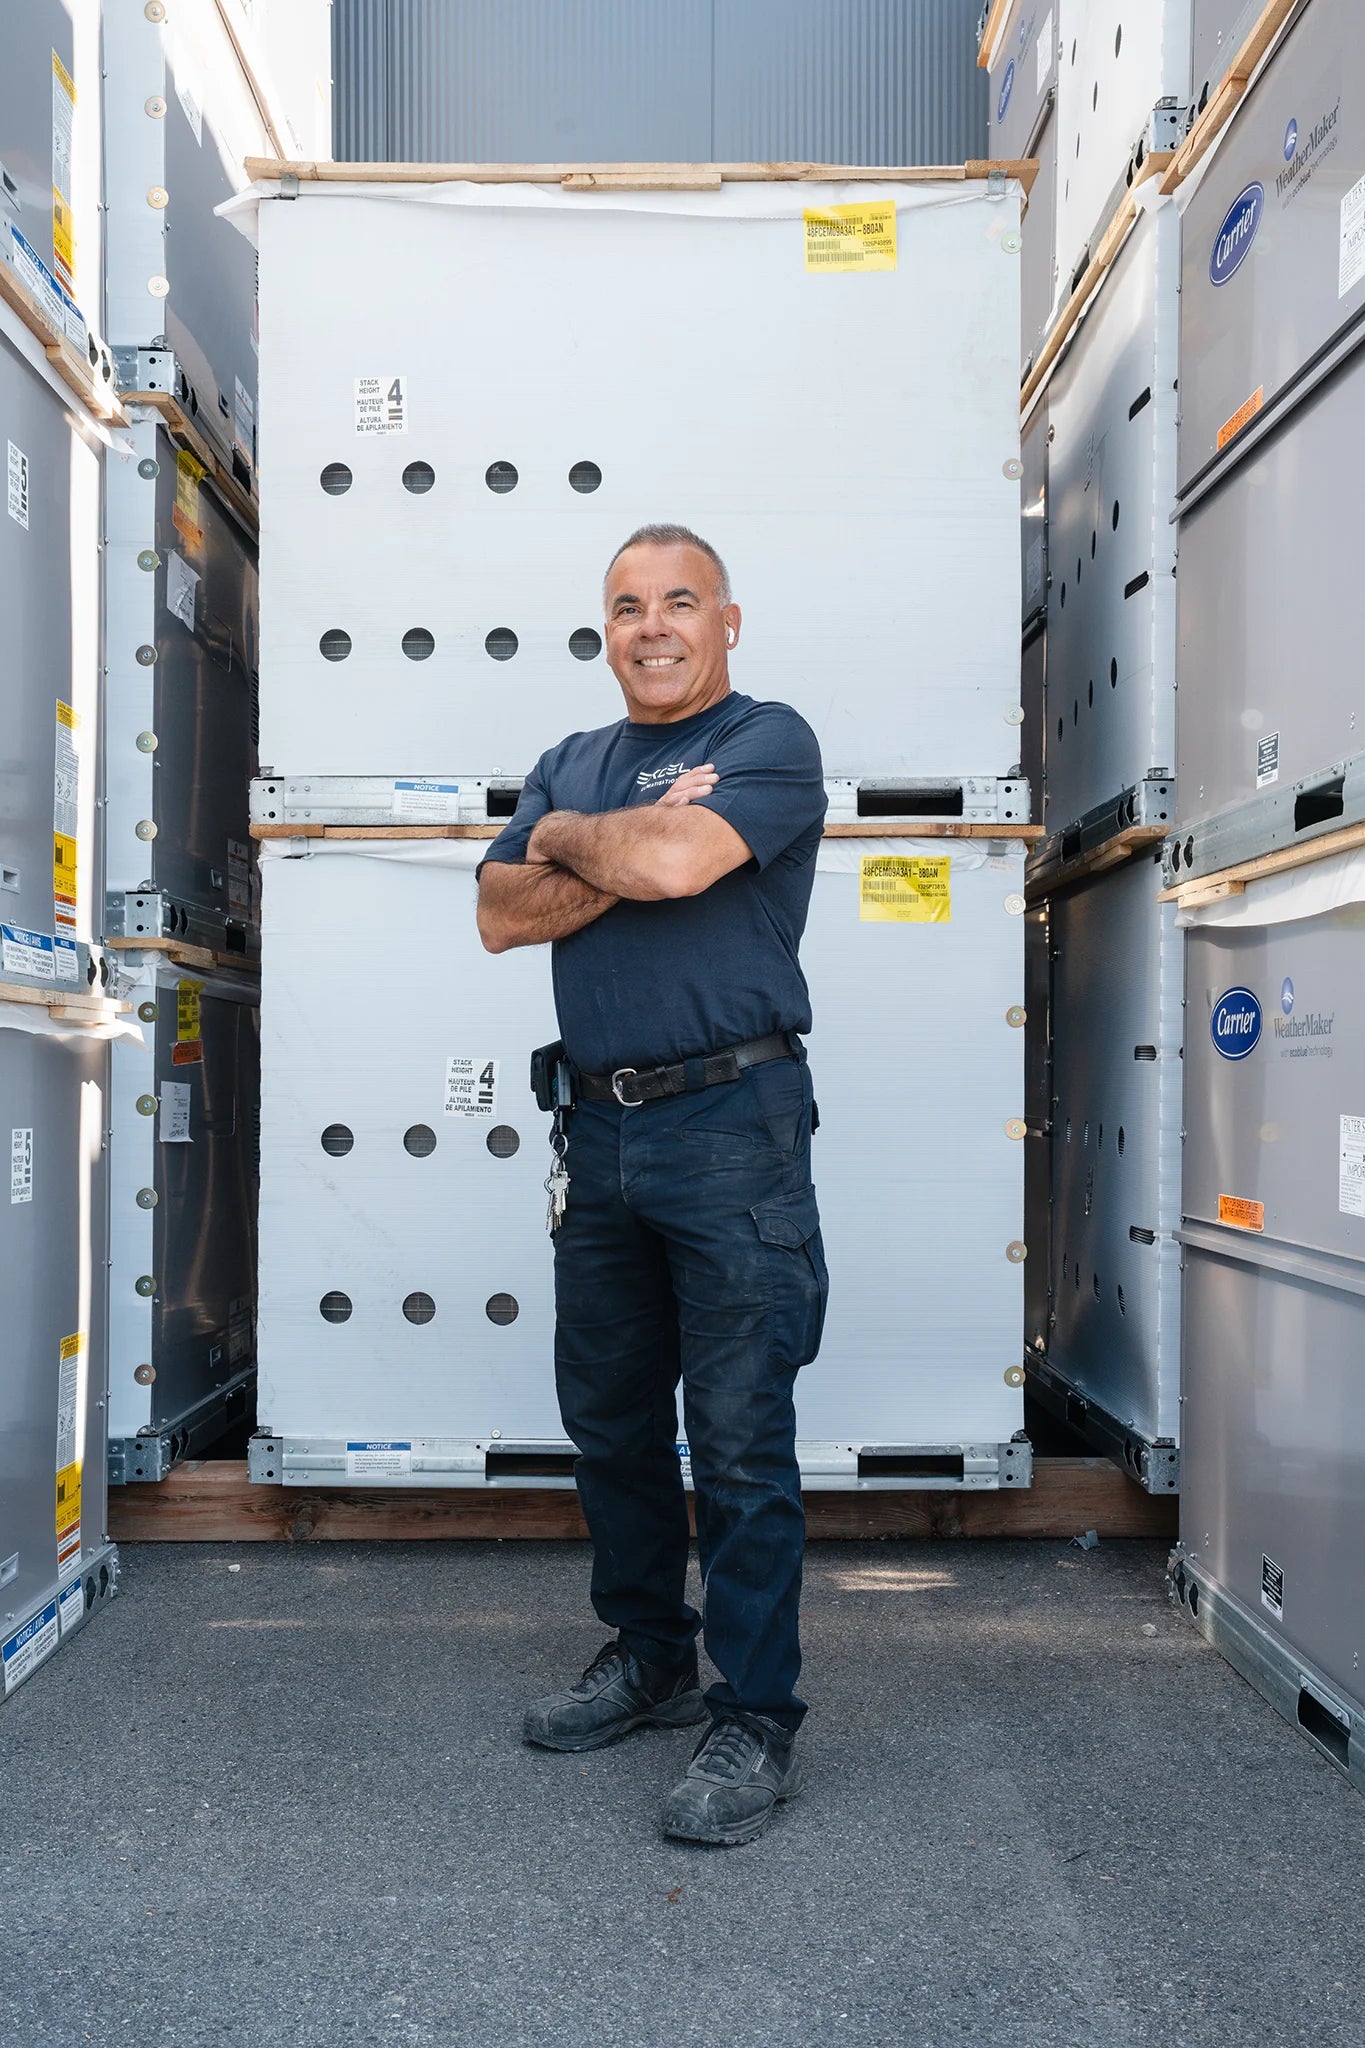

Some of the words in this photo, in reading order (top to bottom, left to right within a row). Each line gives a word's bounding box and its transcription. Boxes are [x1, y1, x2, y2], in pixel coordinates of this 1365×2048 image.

[1216, 199, 1257, 268] Carrier
[387, 379, 403, 406] 4
[21, 456, 27, 493] 5
[413, 783, 440, 792] NOTICE
[1217, 1007, 1256, 1037] Carrier
[1273, 1013, 1333, 1039] WeatherMaker
[447, 1078, 475, 1086] HAUTEUR
[479, 1061, 495, 1089] 4
[449, 1096, 471, 1104] ALTURA
[454, 1104, 491, 1113] APILAMIENTO
[1343, 1118, 1362, 1133] FILTER
[25, 1131, 31, 1166] 5
